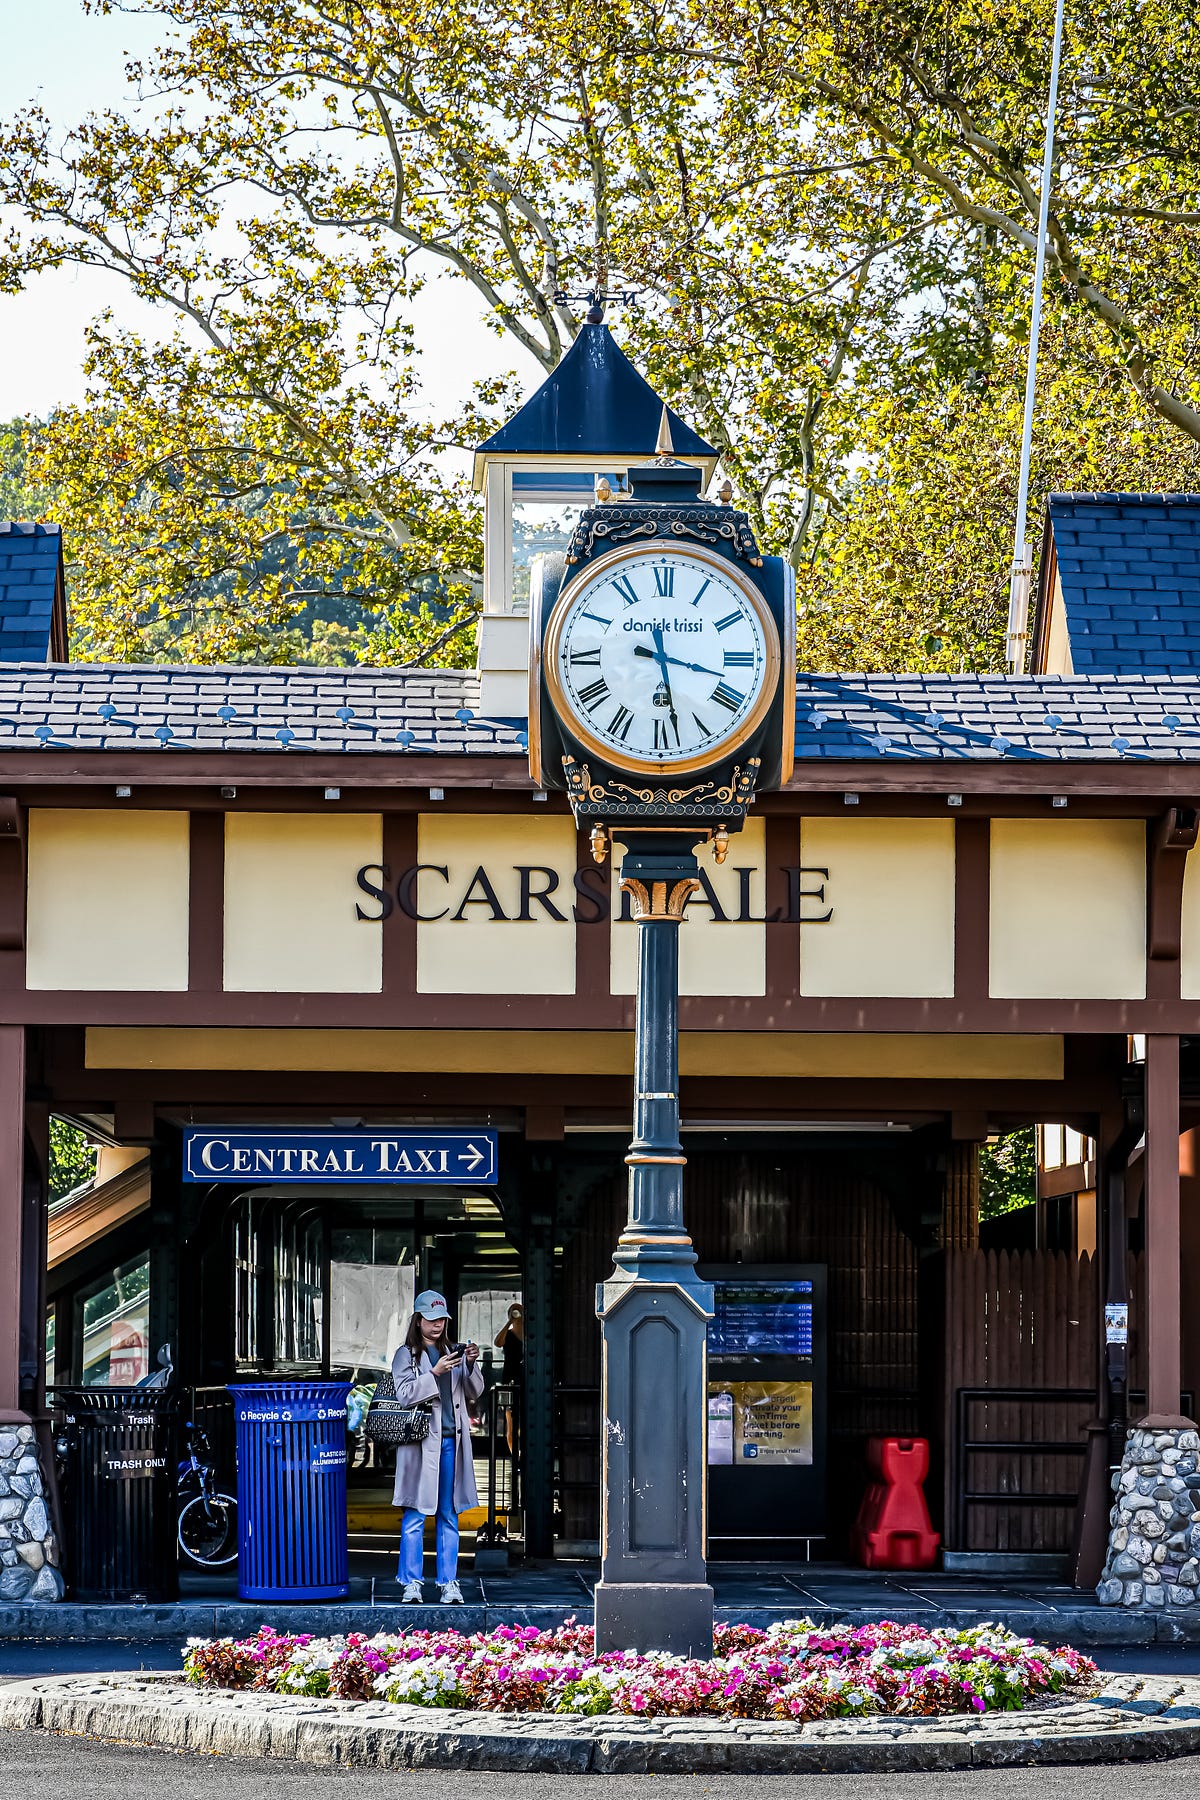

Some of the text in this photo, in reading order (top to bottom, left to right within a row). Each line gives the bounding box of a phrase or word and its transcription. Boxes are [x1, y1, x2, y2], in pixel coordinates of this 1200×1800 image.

[622, 618, 703, 632] daniele trissi
[355, 864, 835, 923] SCARSALE
[201, 1139, 450, 1173] CENTRAL TAXI
[127, 1415, 154, 1425] Trash
[247, 1411, 279, 1422] Recycle
[744, 1412, 788, 1420] rainTime
[770, 1421, 800, 1429] before
[107, 1458, 166, 1470] TRASH ONLY
